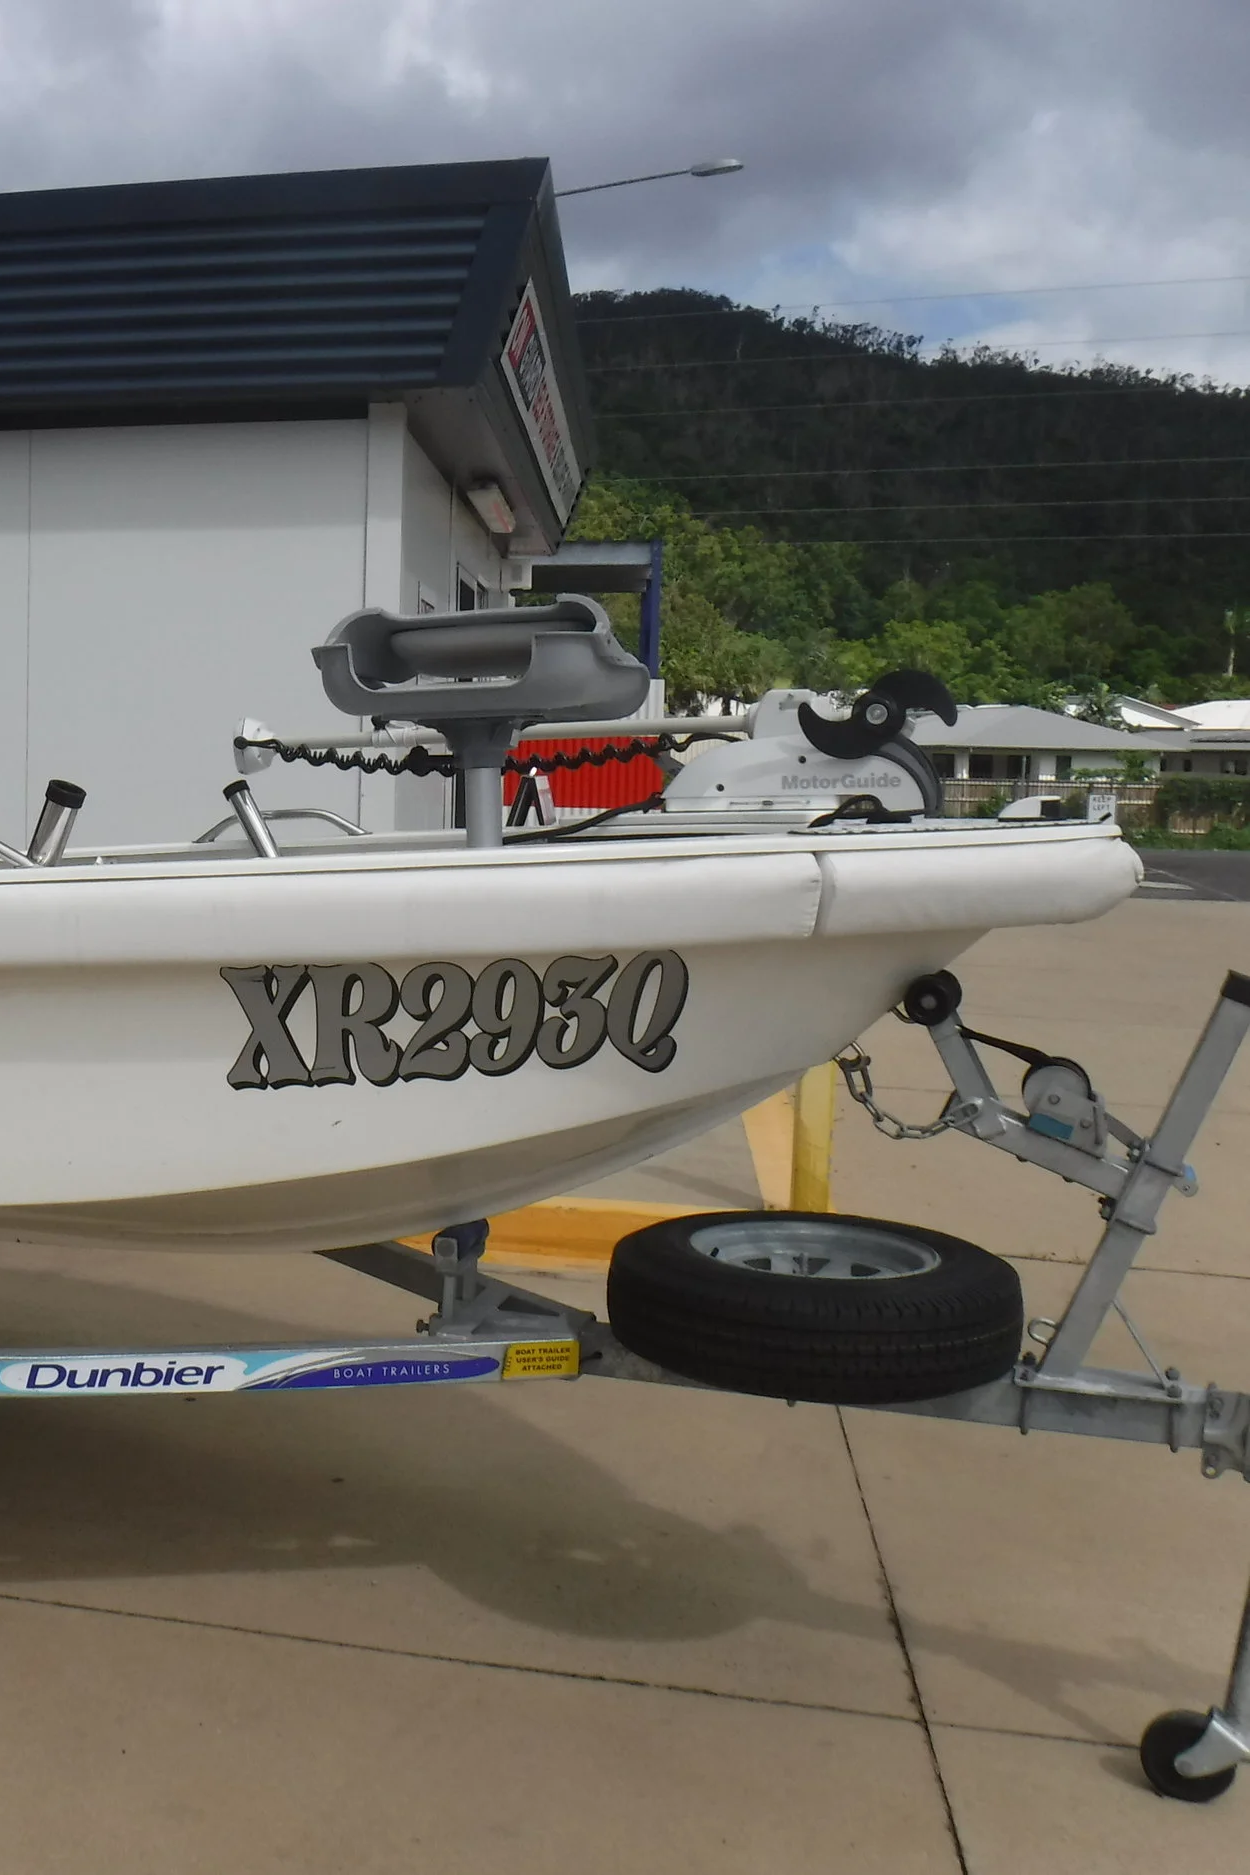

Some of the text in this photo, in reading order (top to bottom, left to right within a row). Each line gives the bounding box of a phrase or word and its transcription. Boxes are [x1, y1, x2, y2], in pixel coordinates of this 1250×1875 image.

[781, 773, 902, 790] MotorGuide
[220, 949, 688, 1090] XR293Q
[25, 1361, 451, 1388] Dunbier BOAT TRAILERS
